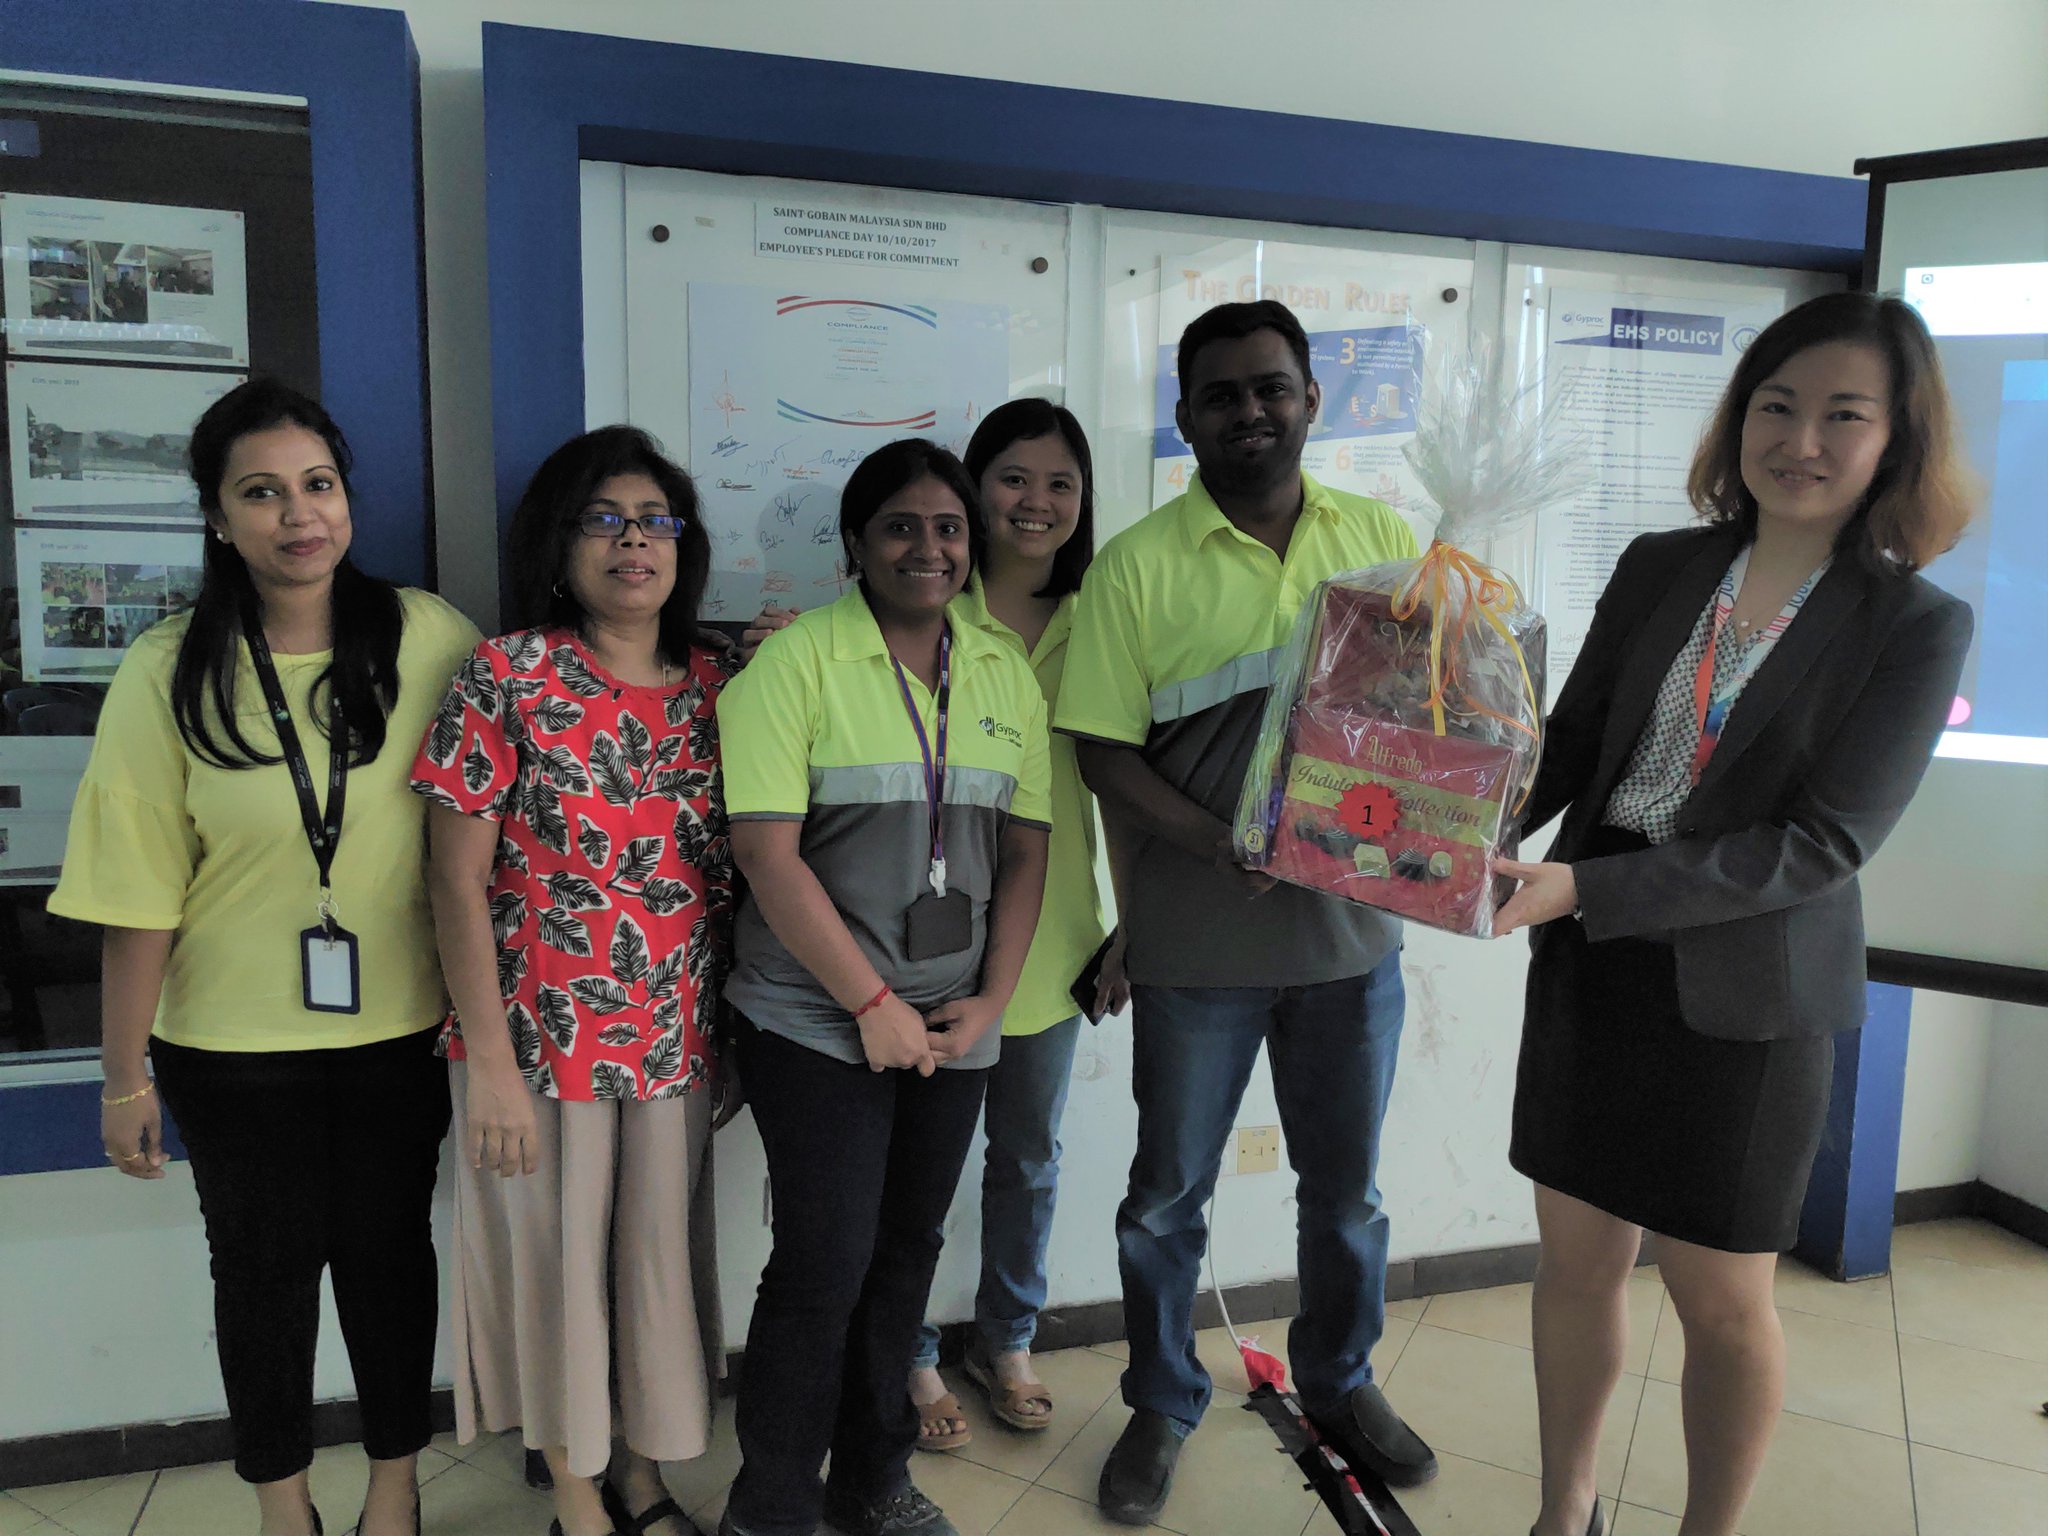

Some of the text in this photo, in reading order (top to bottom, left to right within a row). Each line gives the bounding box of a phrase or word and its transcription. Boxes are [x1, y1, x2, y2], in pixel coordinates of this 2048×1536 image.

[773, 206, 947, 232] SAINT GOBAIN MALAYSIA SDN BHD
[784, 226, 936, 248] COMPLIANCE DAY 10/10/2017
[759, 242, 960, 267] EMPLOYEE'S PLEDGE FOR COMMITMENT
[1183, 269, 1230, 302] THE
[1344, 281, 1410, 315] RULES
[826, 321, 889, 332] COMPLIANCE
[1575, 313, 1604, 325] Gyproc
[1613, 323, 1721, 347] EHS POLICY
[1340, 337, 1356, 365] 3
[1335, 444, 1352, 471] 6
[1167, 463, 1185, 490] 4
[1366, 735, 1423, 774] Alfredo
[1361, 804, 1374, 826] 1
